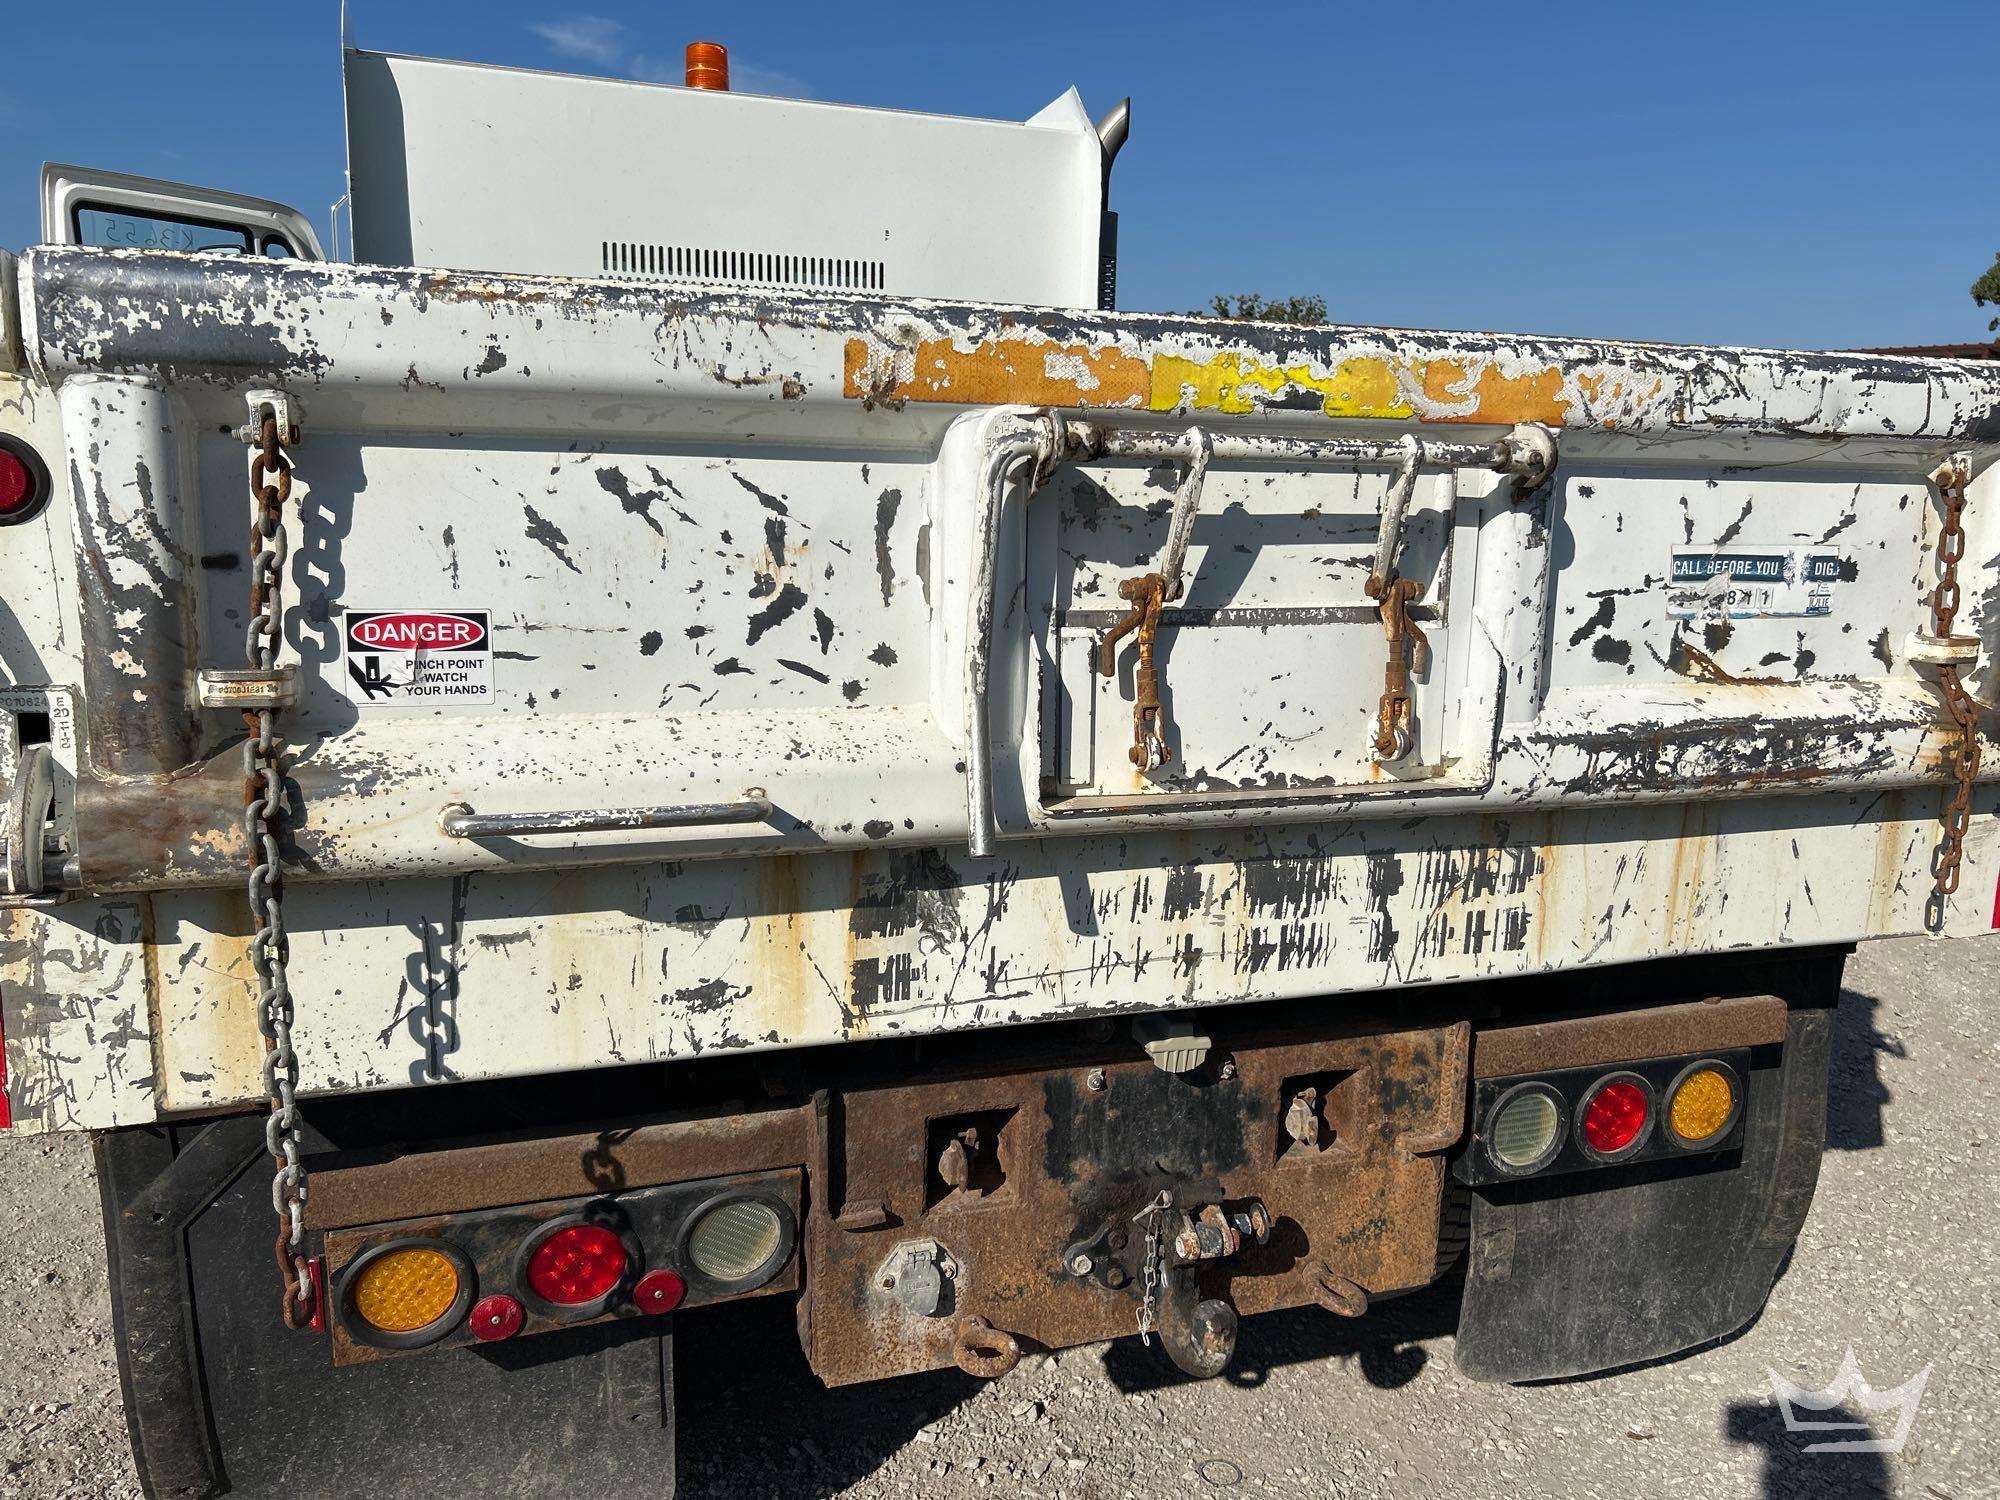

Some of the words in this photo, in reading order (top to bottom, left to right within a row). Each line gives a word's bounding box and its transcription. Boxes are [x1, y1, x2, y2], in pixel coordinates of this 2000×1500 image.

[1673, 560, 1702, 575] CALL
[1706, 560, 1753, 575] BEFORE
[1756, 561, 1779, 576] YOU
[364, 623, 472, 642] DANGER
[405, 659, 444, 670] PINCH
[447, 659, 485, 669] POINT
[424, 673, 468, 682] WATCH
[405, 686, 442, 696] YOUR
[444, 685, 487, 695] HANDS
